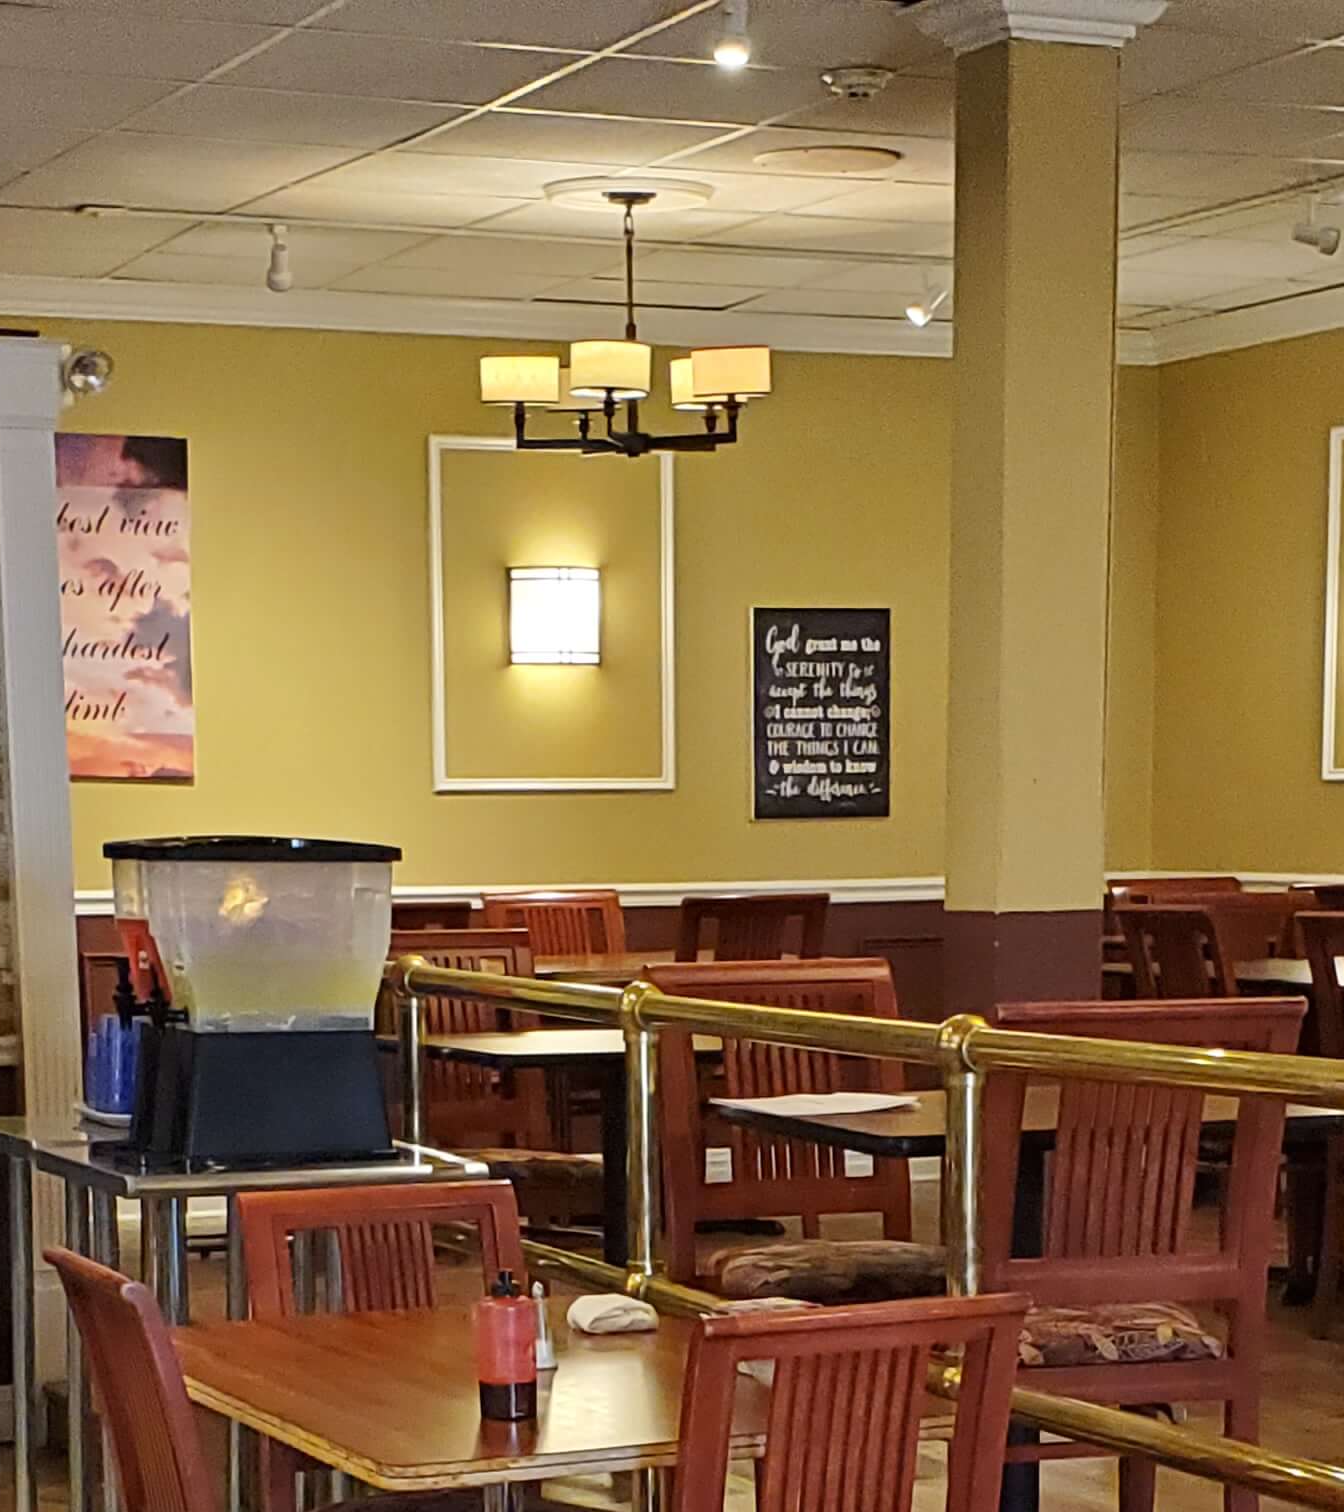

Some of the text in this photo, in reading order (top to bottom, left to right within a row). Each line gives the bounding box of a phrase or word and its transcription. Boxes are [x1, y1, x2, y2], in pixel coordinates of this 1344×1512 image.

[119, 508, 179, 536] view
[97, 569, 162, 612] after
[62, 627, 171, 661] hardest
[861, 637, 881, 652] the
[785, 661, 846, 678] SERENITY
[813, 677, 833, 699] the
[767, 722, 878, 738] COURAGE TO CHANGE
[767, 740, 789, 756] THE
[797, 740, 839, 756] THINGS
[853, 740, 880, 756] CAN
[829, 760, 842, 774] to
[845, 759, 877, 774] know
[780, 775, 801, 798] the
